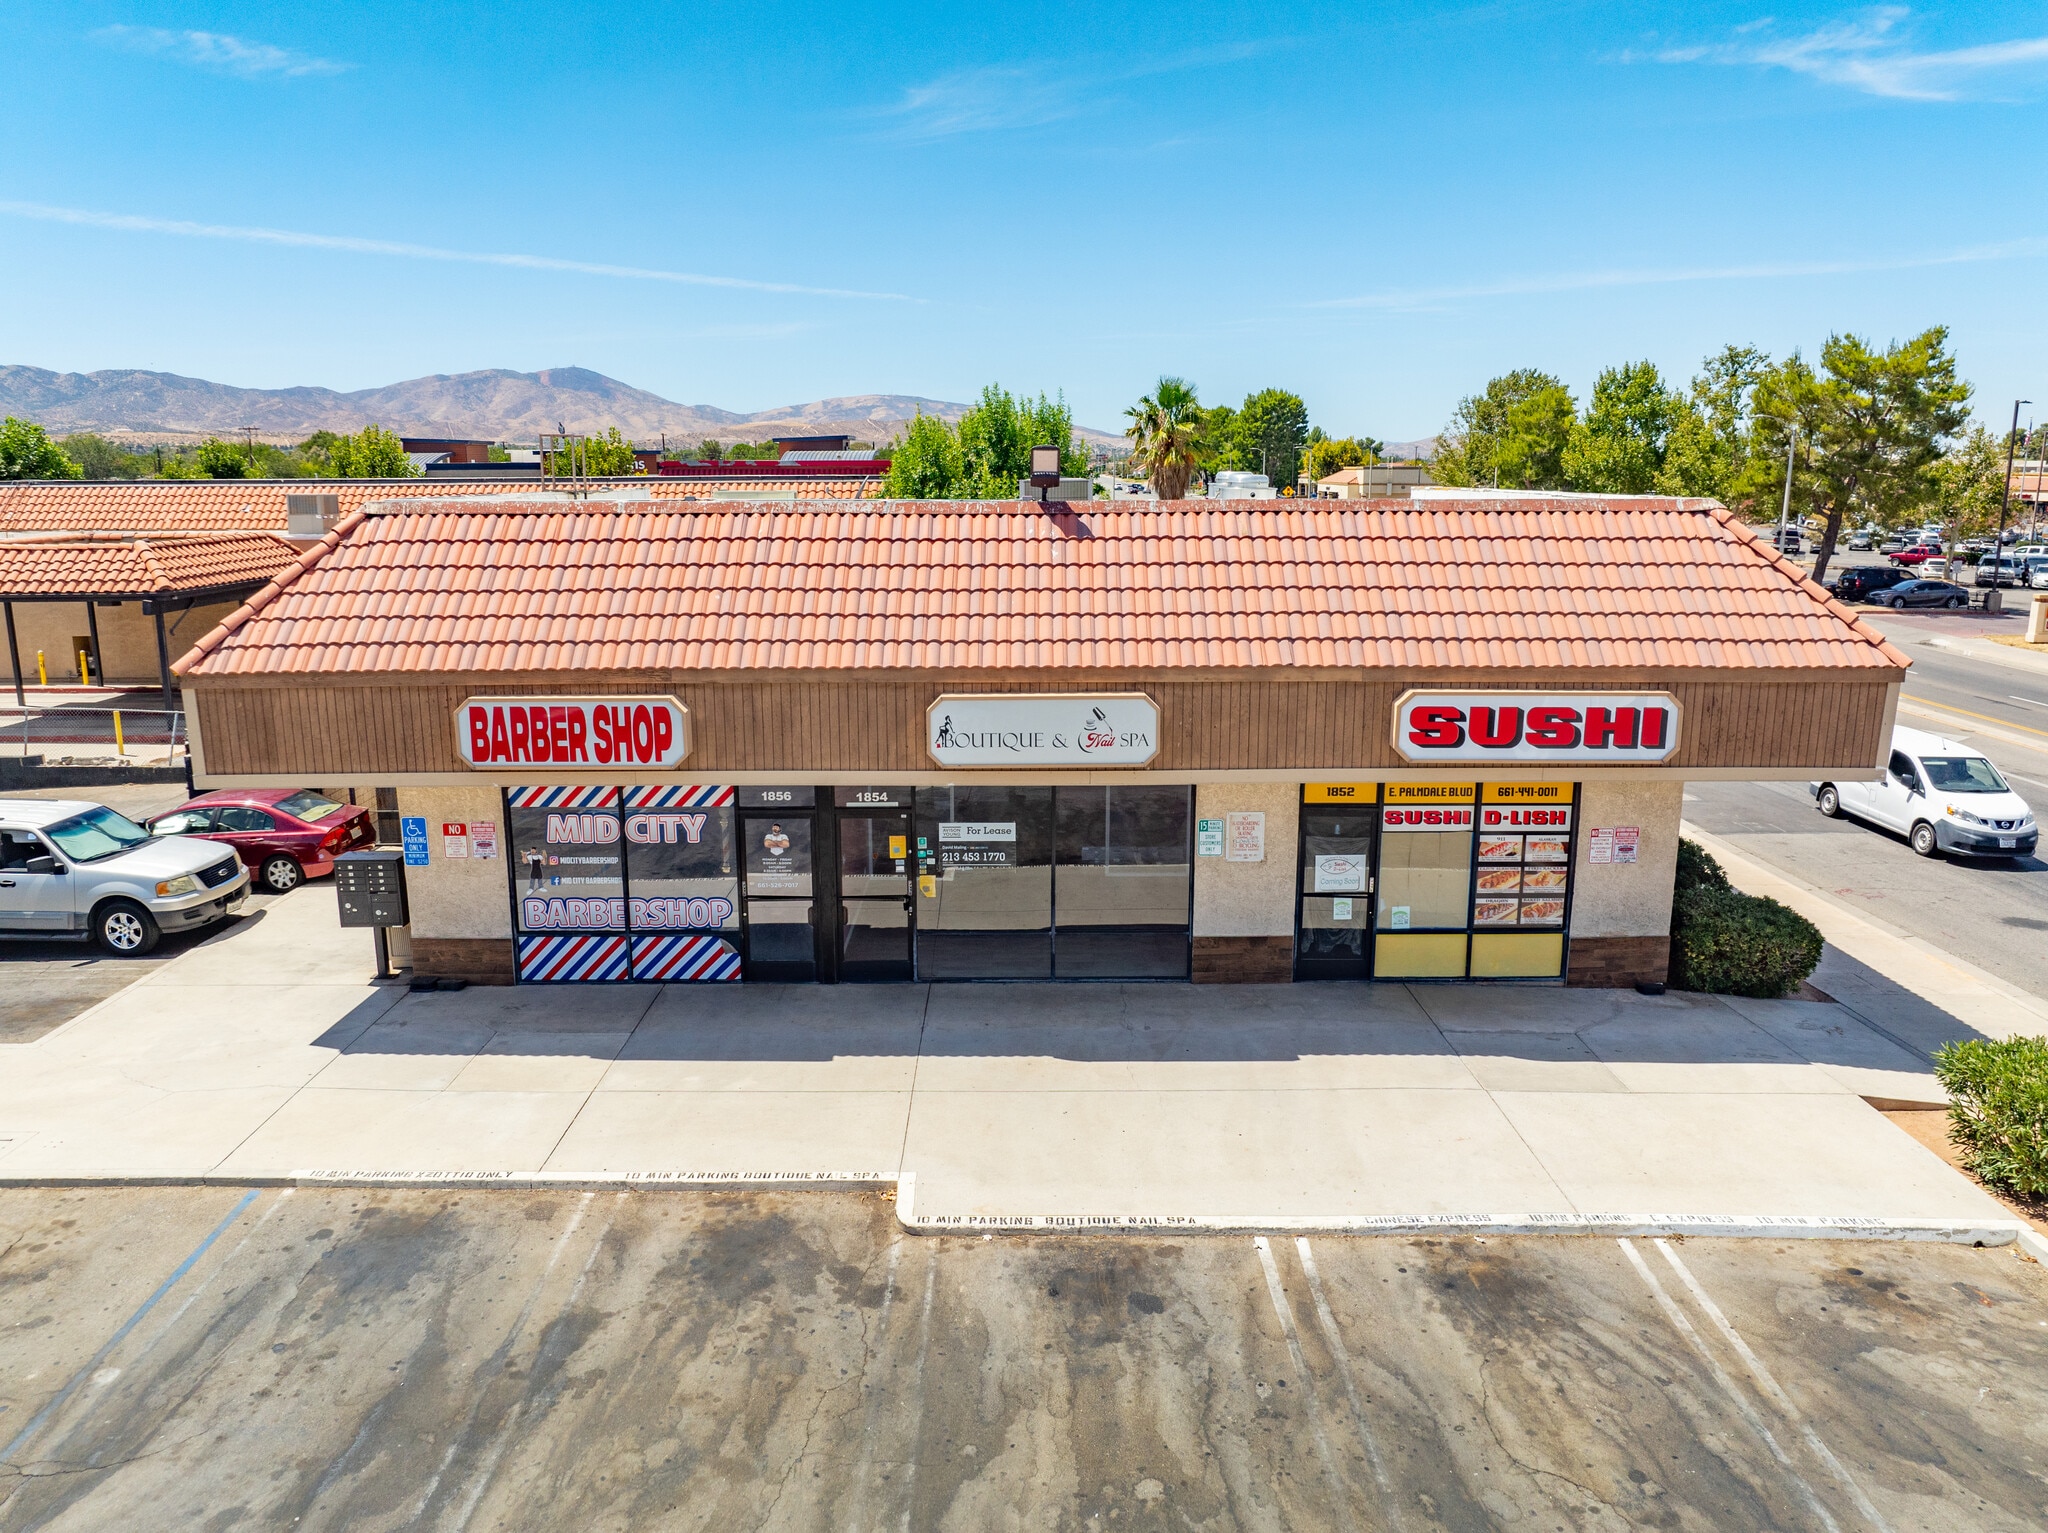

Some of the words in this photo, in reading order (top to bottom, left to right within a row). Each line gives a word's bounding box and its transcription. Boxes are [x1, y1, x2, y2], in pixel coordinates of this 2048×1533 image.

[1408, 706, 1669, 749] SUSHI
[469, 706, 589, 762] BARBER
[593, 704, 673, 763] SHOP
[943, 732, 1044, 752] BOUTIQUE
[1052, 733, 1069, 748] &
[1085, 732, 1115, 748] Nail
[1120, 733, 1149, 747] SPA
[761, 791, 792, 801] 1856
[1327, 787, 1354, 796] 1852
[1389, 788, 1397, 796] E.
[1399, 788, 1447, 796] PALMDALE
[1498, 787, 1557, 796] 661-441-0011
[856, 792, 888, 802] 1854
[1384, 811, 1471, 825] SUSHI
[1484, 811, 1566, 825] D-LISH
[448, 825, 460, 834] NO
[546, 813, 621, 843] MID
[624, 813, 707, 844] CITY
[1200, 822, 1208, 830] 15
[942, 853, 959, 861] 213
[962, 853, 979, 861] 453
[983, 853, 1005, 861] 1770
[561, 877, 572, 885] MID
[573, 877, 585, 885] CITY
[524, 897, 733, 929] BARBERSHOP
[968, 1216, 1033, 1225] PARKING
[1045, 1216, 1121, 1225] BOUTIQUE
[1128, 1216, 1162, 1224] NAIL
[1168, 1216, 1196, 1224] SPA
[1428, 1214, 1491, 1223] EXPRESS
[1544, 1214, 1569, 1222] MIN
[1780, 1216, 1808, 1225] MIN
[1818, 1216, 1886, 1226] PARKING
